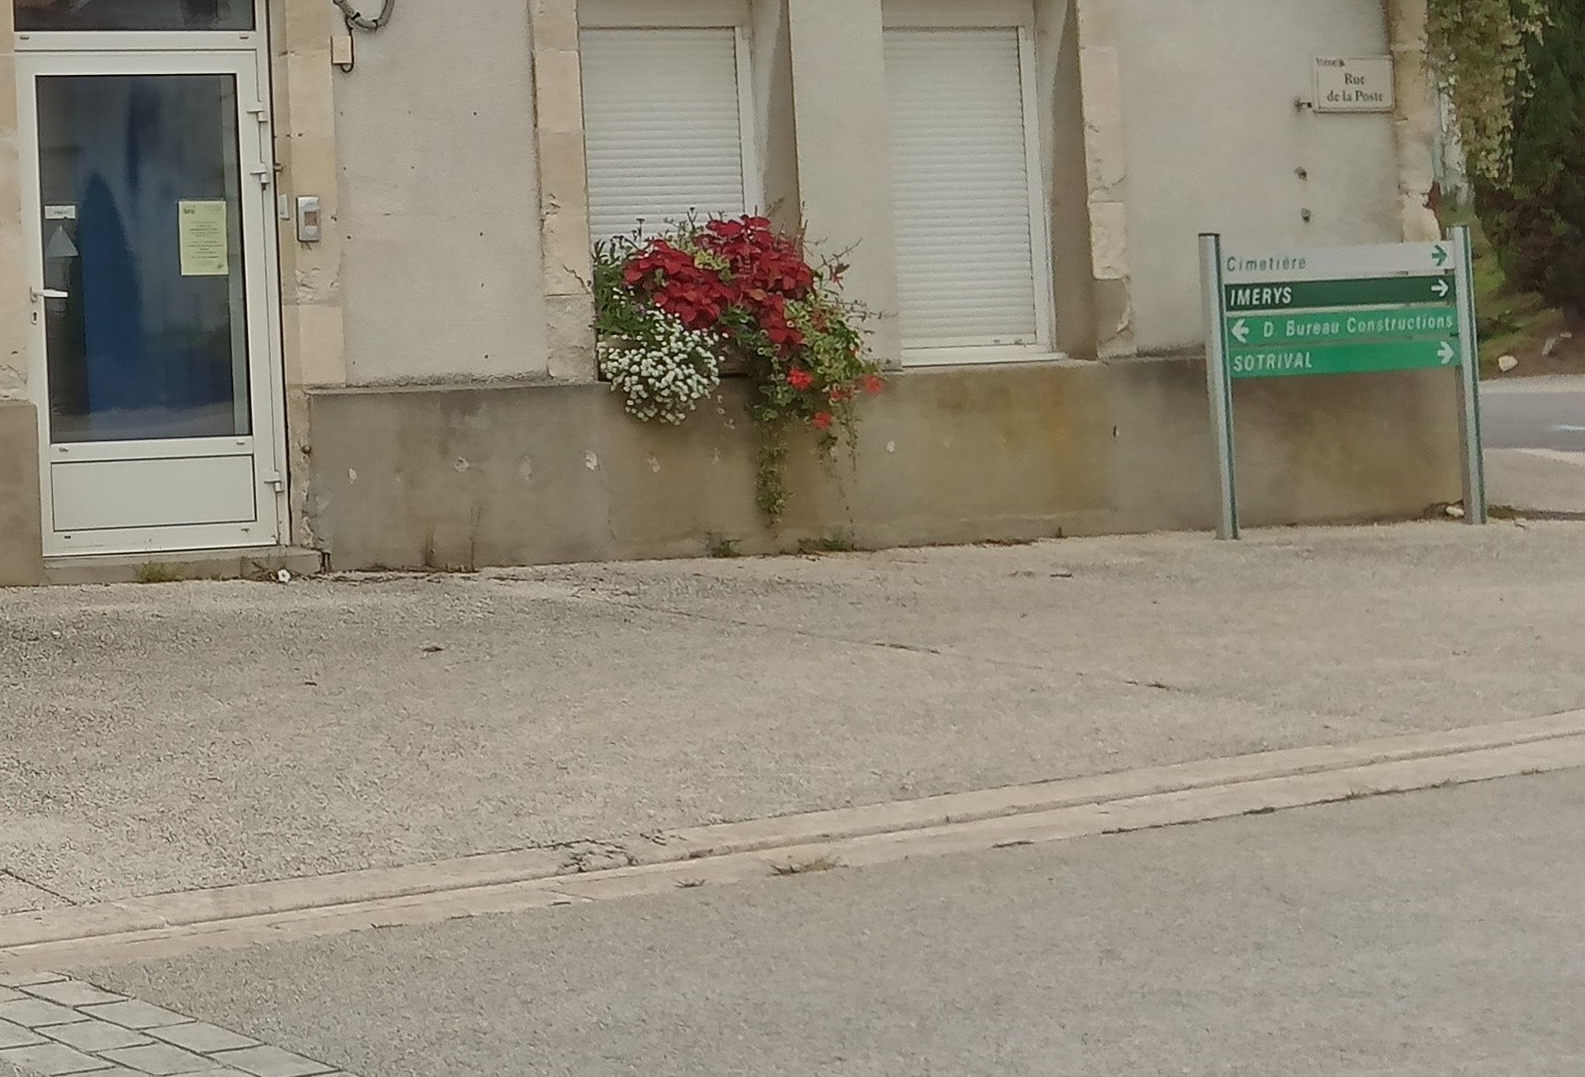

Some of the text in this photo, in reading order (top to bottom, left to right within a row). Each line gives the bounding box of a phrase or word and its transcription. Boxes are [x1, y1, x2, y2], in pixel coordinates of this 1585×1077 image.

[1345, 73, 1365, 85] Rue
[1327, 90, 1383, 102] de la Poste
[1227, 256, 1306, 272] Cimetière
[1230, 286, 1292, 305] IMERYS
[1285, 320, 1340, 337] Bureau
[1346, 313, 1453, 334] Constructions
[1233, 351, 1313, 373] SOTRIVAL
